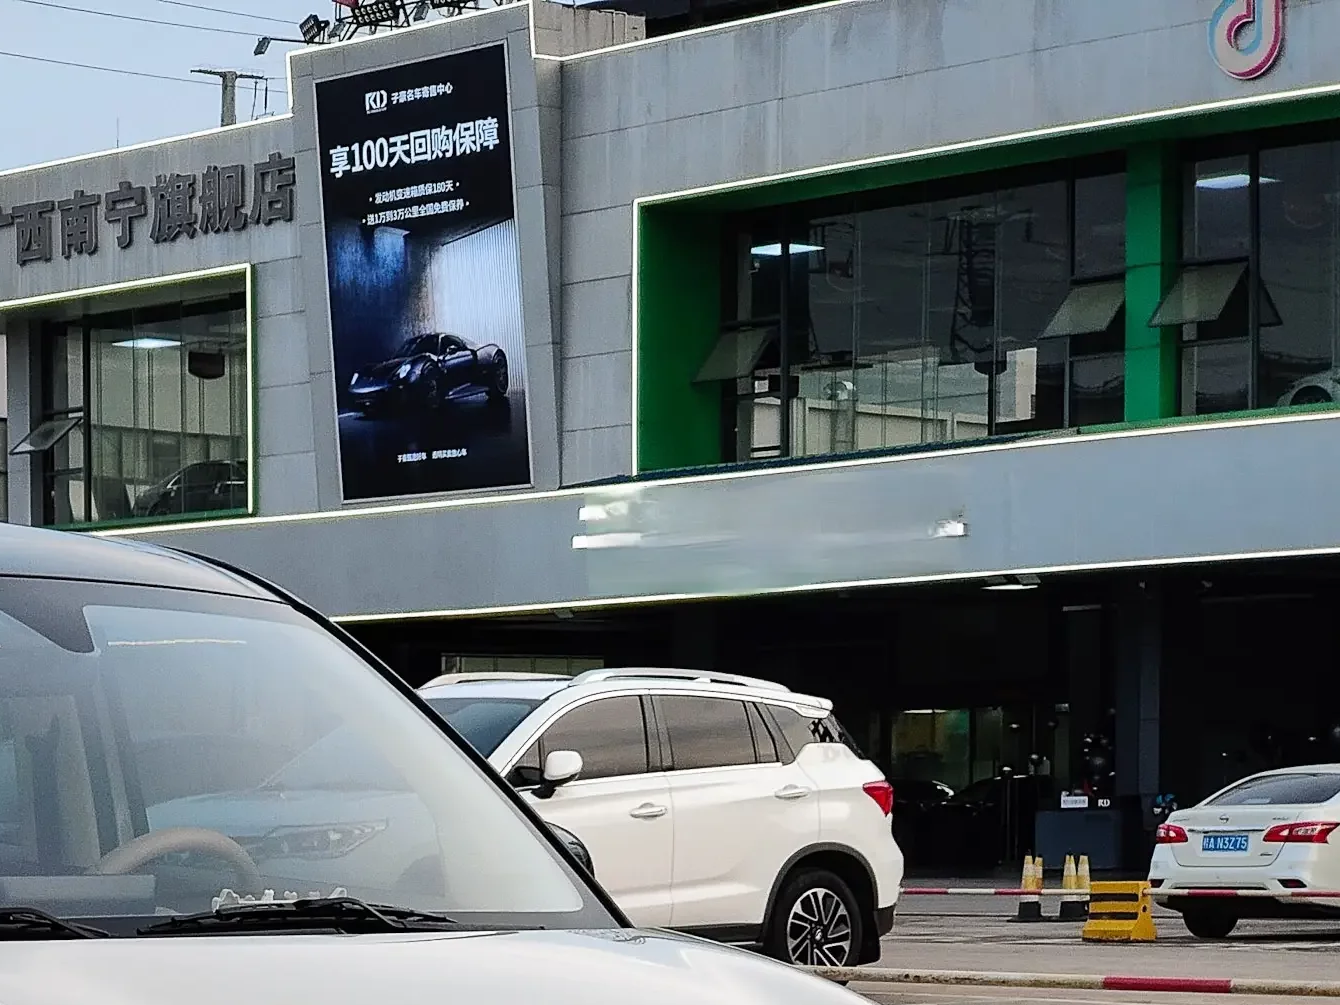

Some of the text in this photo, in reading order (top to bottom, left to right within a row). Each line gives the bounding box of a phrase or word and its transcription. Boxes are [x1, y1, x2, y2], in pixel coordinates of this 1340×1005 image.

[329, 116, 500, 179] 享100天回购保障
